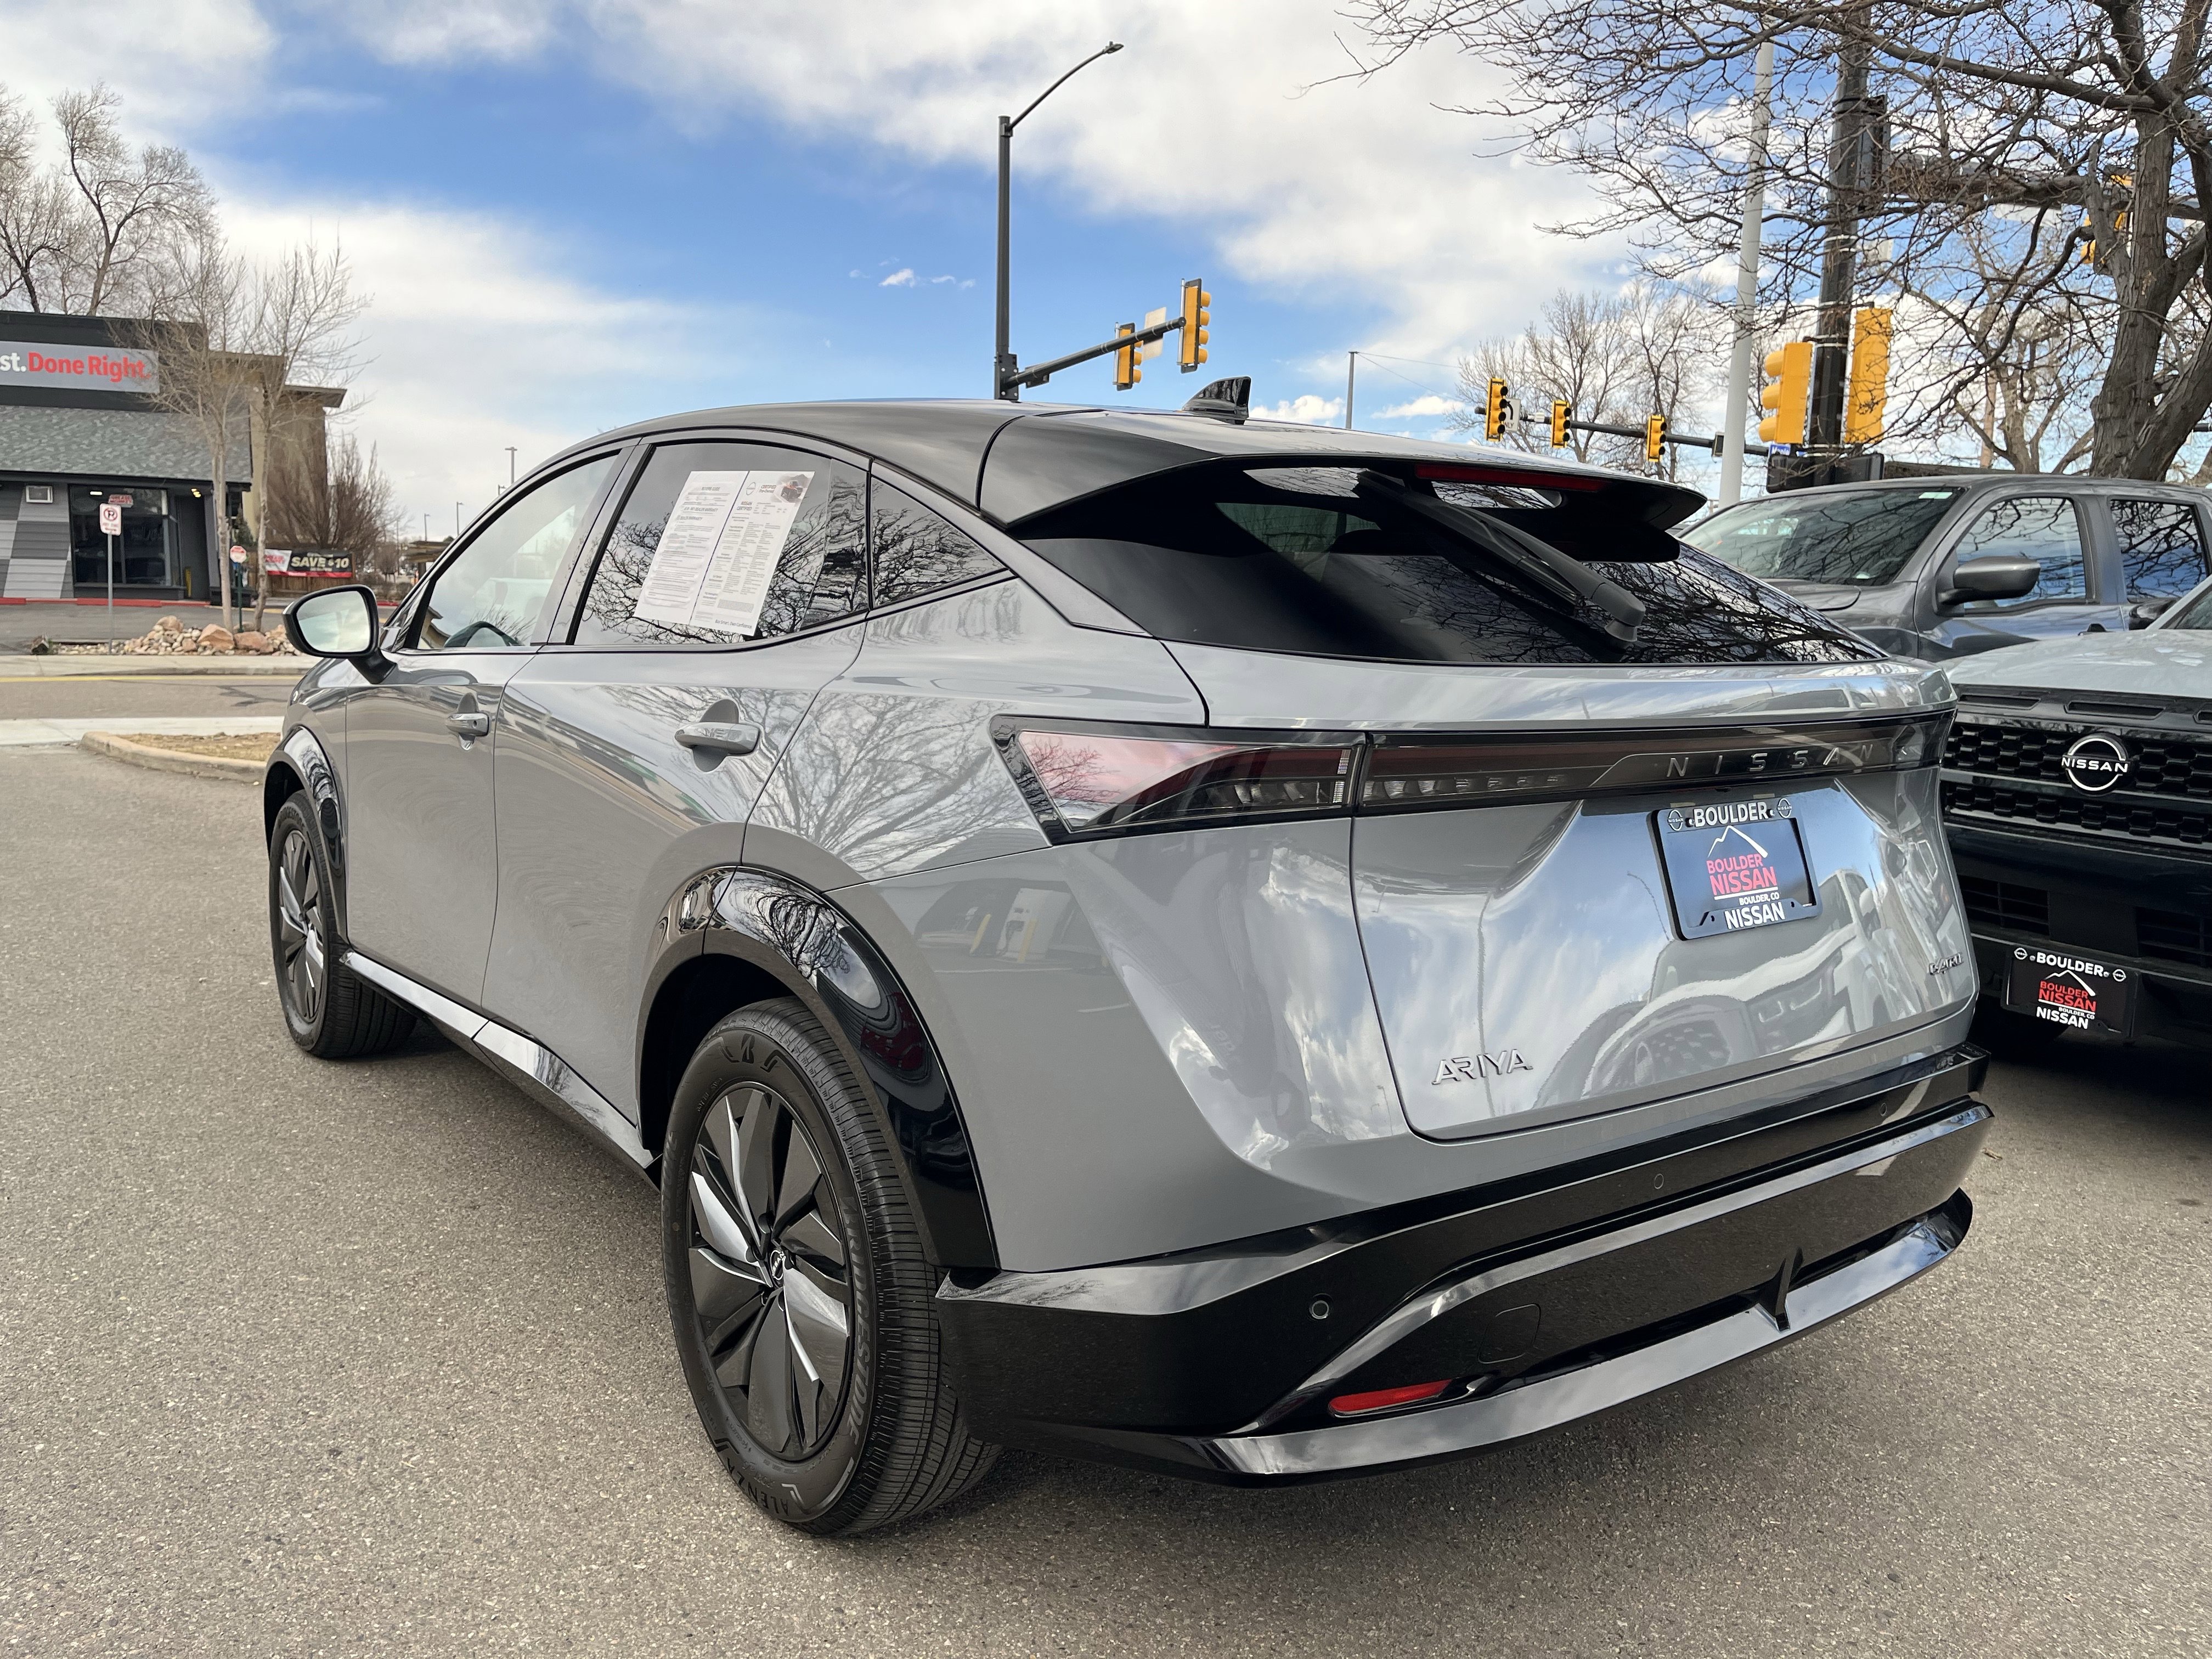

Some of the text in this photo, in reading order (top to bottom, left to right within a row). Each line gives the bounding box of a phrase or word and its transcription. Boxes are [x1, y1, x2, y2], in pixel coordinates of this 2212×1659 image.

[27, 351, 84, 375] Done
[291, 556, 326, 568] SAVE
[1666, 744, 1874, 778] NISSAN
[2061, 757, 2129, 773] NISSAN
[1693, 802, 1769, 828] BOULDER
[1706, 854, 1764, 874] BOULDER
[1709, 866, 1778, 896] NISSAN
[1739, 892, 1780, 906] BOULDER, CO
[1724, 901, 1786, 930] NISSAN
[2036, 952, 2104, 977] BOULDER
[2039, 989, 2097, 1012] NISSAN
[2040, 981, 2089, 999] BOULDER
[2036, 1007, 2089, 1030] NISSAN
[1431, 1048, 1533, 1085] ARIYA
[843, 1195, 871, 1447] BRIDGESTONE
[726, 1457, 789, 1516] ALENZA
